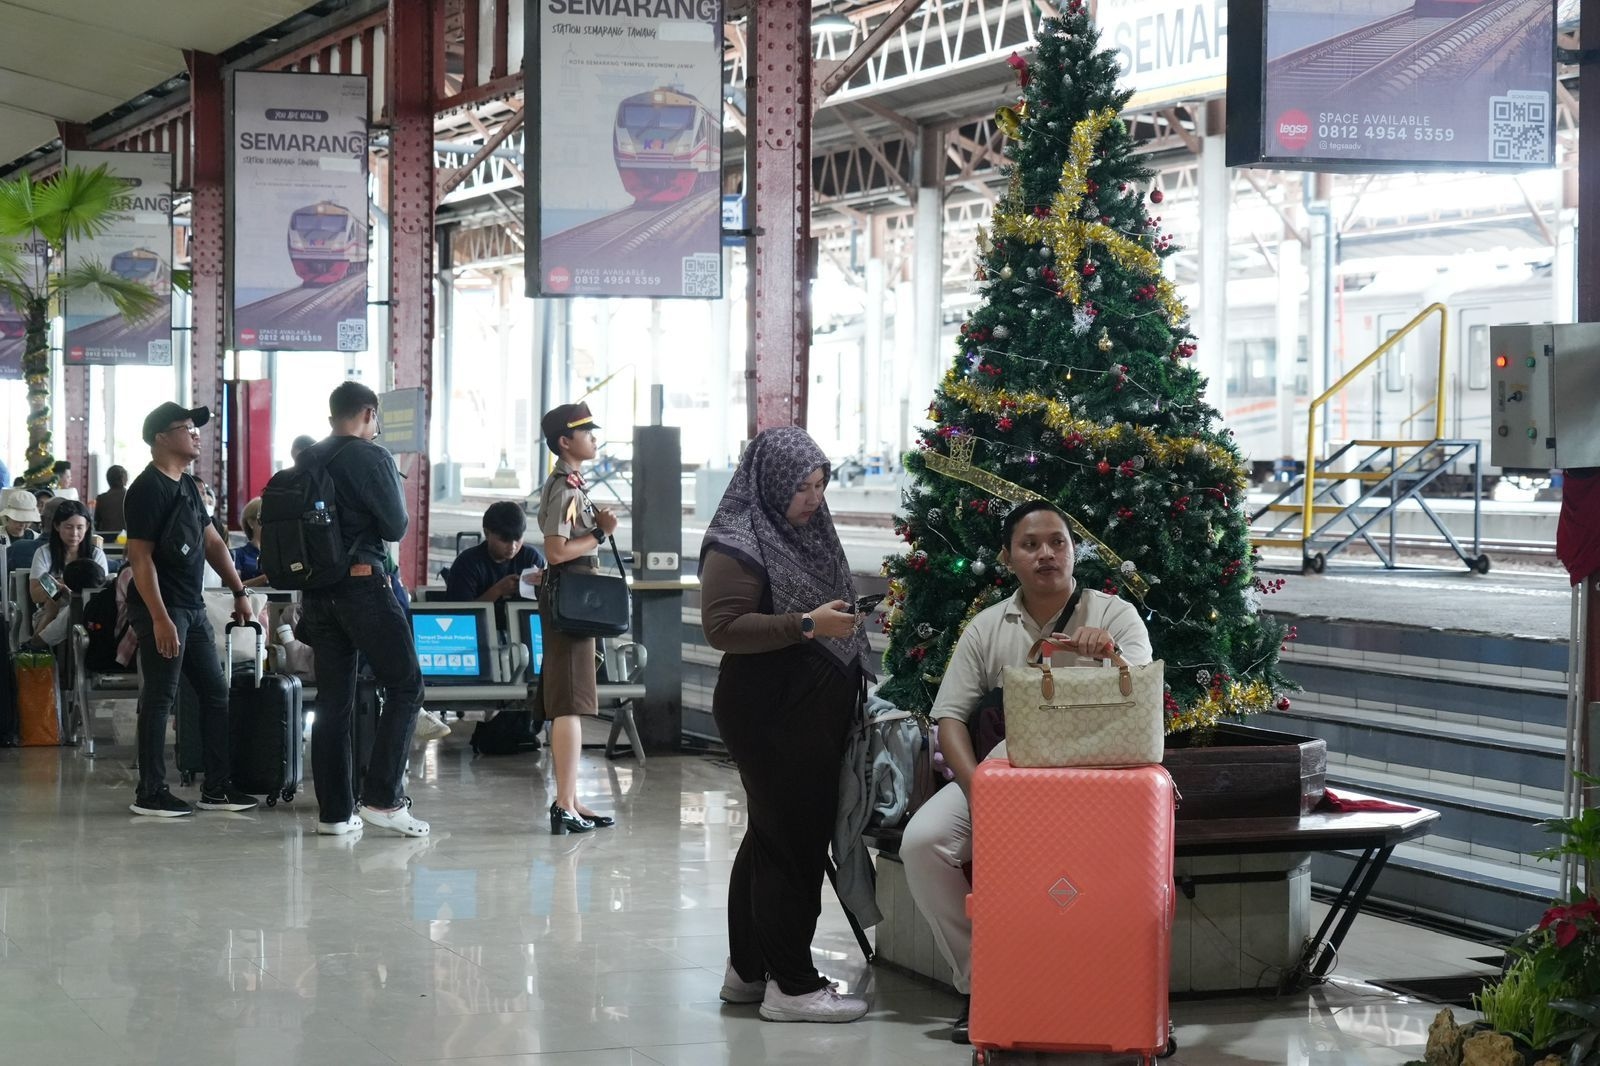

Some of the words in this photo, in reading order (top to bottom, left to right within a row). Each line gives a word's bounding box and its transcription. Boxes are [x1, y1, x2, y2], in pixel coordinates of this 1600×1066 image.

[549, 0, 718, 21] SEMARANG
[552, 24, 581, 35] STATION
[584, 26, 623, 37] SEMARANG
[627, 27, 656, 39] TAWANG
[1319, 112, 1359, 124] SPACE
[1363, 114, 1430, 126] AVAILABLE
[1318, 125, 1358, 139] 0812
[1364, 126, 1407, 140] 4954
[1413, 128, 1455, 142] 5359
[240, 132, 362, 153] SEMARANG
[576, 268, 600, 276] SPACE
[575, 275, 600, 284] 0812
[603, 276, 631, 285] 4954
[634, 277, 661, 286] 5359
